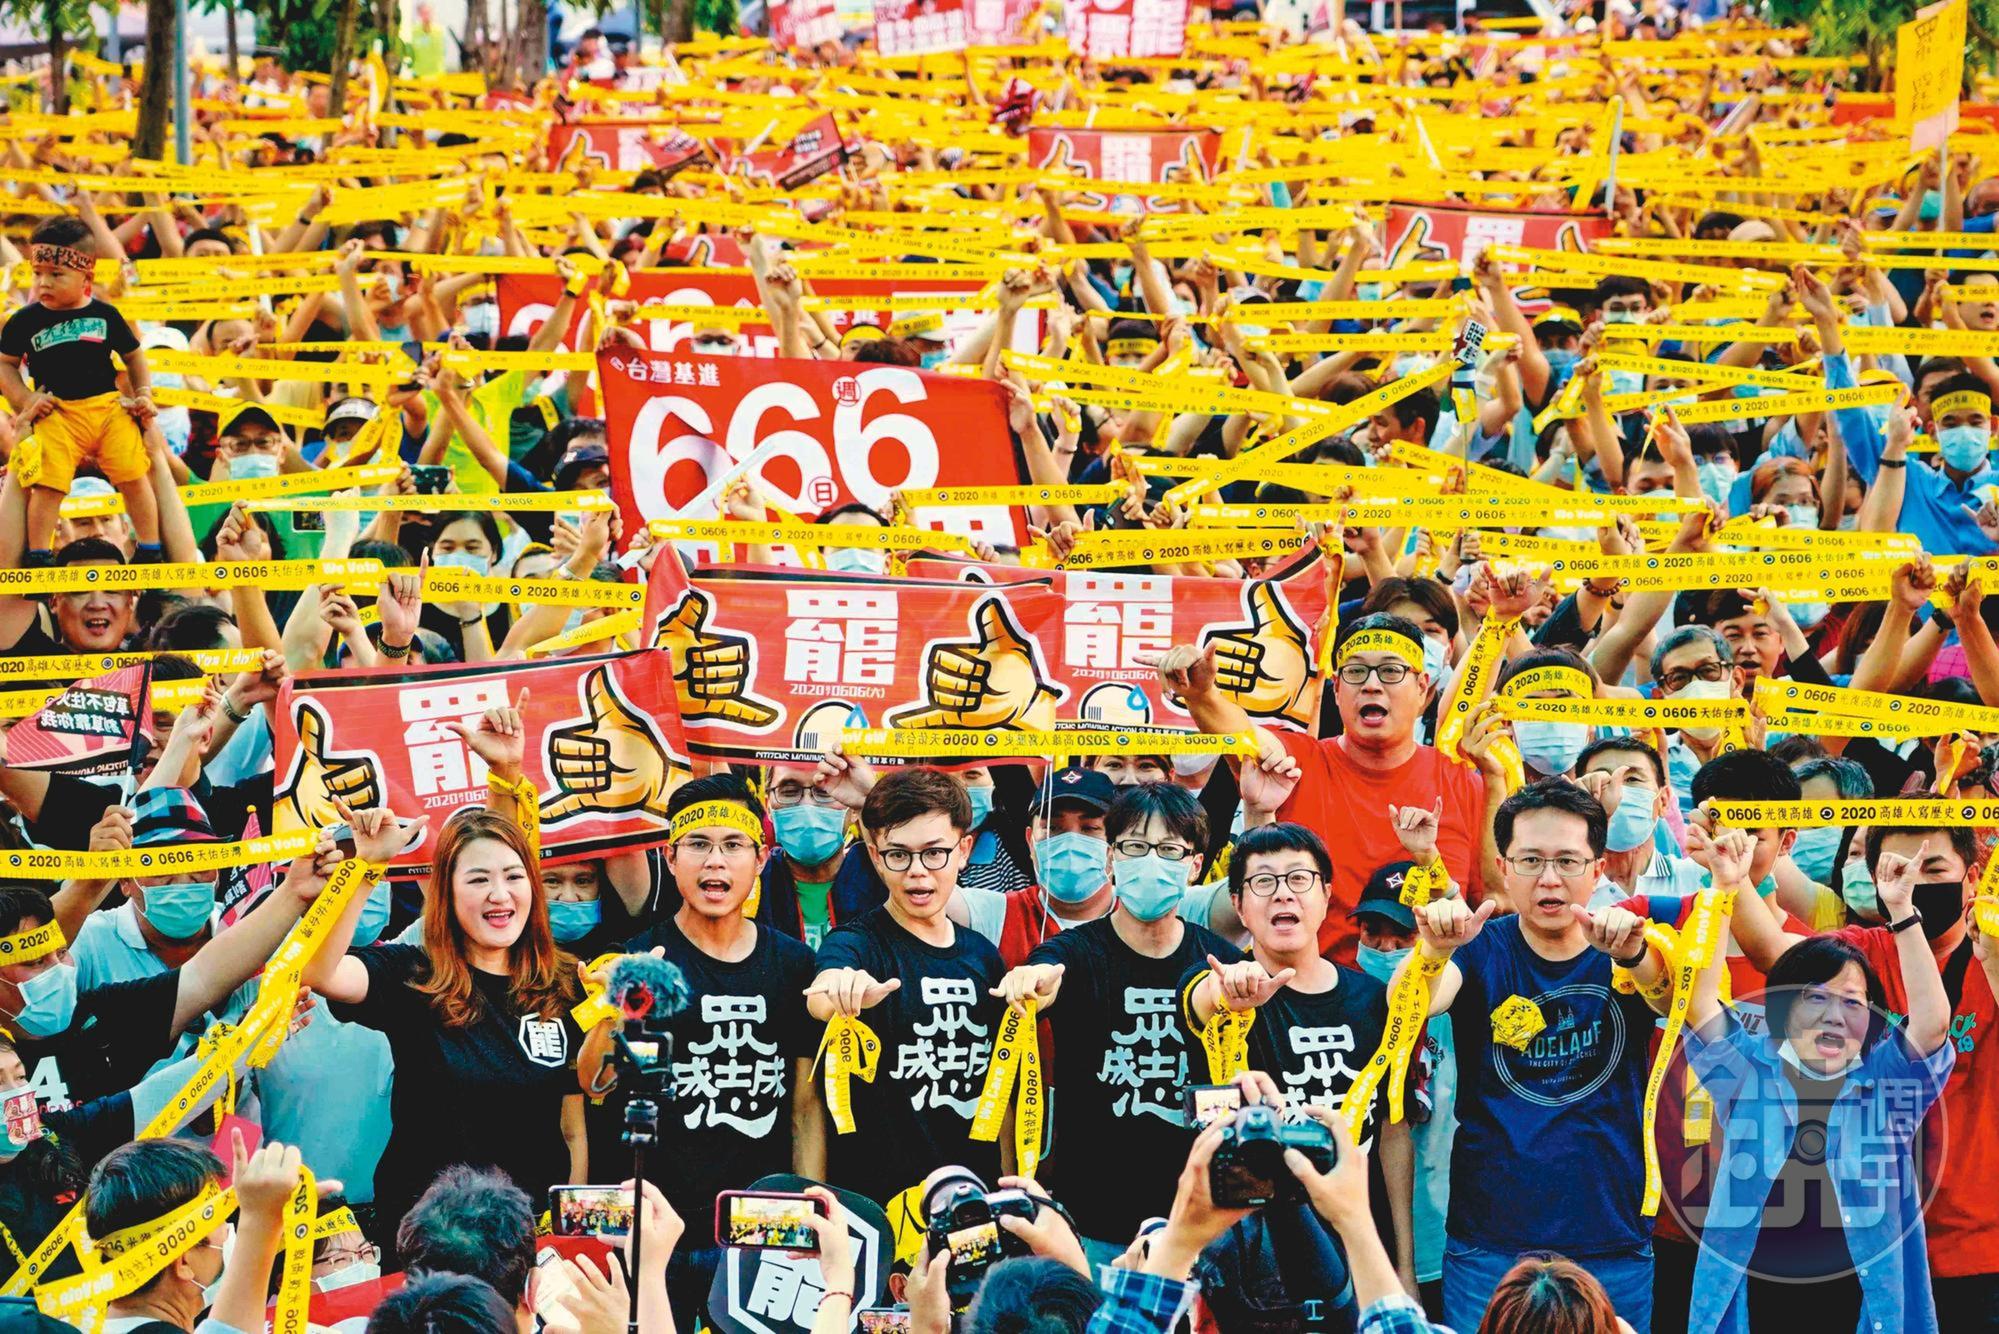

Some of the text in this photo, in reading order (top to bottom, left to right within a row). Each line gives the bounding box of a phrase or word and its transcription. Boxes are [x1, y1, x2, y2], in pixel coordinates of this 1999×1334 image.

[627, 360, 720, 387] 台灣基進
[837, 380, 858, 402] 週
[1838, 391, 1866, 403] 0606
[814, 482, 834, 503] 日
[953, 490, 979, 501] 2020
[1363, 508, 1392, 519] 2020
[1475, 509, 1506, 519] 0606
[700, 525, 728, 538] 0606
[786, 529, 814, 541] 2020
[892, 533, 922, 545] 0606
[1159, 546, 1190, 559] 2020
[1569, 559, 1599, 571] 0606
[1664, 556, 1693, 568] 2020
[1780, 553, 1812, 564] 0606
[0, 569, 33, 584] 0606
[34, 569, 79, 584] 光復高雄
[104, 568, 138, 582] 2020
[140, 567, 209, 582] 高雄人寫歷史
[233, 565, 269, 579] 0606
[272, 563, 316, 578] 天佑台灣
[1635, 576, 1664, 587] 0606
[1725, 572, 1753, 584] 2020
[1835, 568, 1865, 579] 0606
[429, 581, 460, 594] 0606
[527, 585, 558, 598] 2020
[1840, 587, 1869, 597] 0606
[1064, 571, 1174, 669] 罷
[784, 590, 899, 686] 罷
[1345, 634, 1370, 651] 2020
[26, 656, 96, 672] 高雄人寫歷史
[1463, 664, 1481, 697] 0606
[1514, 672, 1541, 690] 2020
[1534, 702, 1746, 720] 2020 高雄人寫歷史 0606 天佑台灣
[1803, 689, 1836, 704] 0606
[1907, 702, 1941, 716] 2020
[1766, 715, 1789, 727] 020
[1878, 722, 1911, 733] 0606
[677, 806, 705, 829] 2020
[1727, 808, 1762, 821] 0606
[1764, 806, 1814, 821] 光復高雄
[1841, 806, 1876, 819] 2020
[1879, 805, 1955, 820] 高雄人寫歷史
[28, 855, 62, 868] 2020
[64, 854, 135, 869] 高雄人寫歷史
[158, 850, 195, 866] 0606
[196, 846, 242, 862] 天佑台灣
[330, 860, 357, 895] 0606
[18, 929, 51, 951] 2020
[1002, 1010, 1021, 1043] 0606
[1387, 1016, 1404, 1051] 0606
[528, 1022, 563, 1059] 罷
[189, 1070, 215, 1099] 0606
[985, 1065, 1006, 1099] Care
[39, 1234, 64, 1263] 0606
